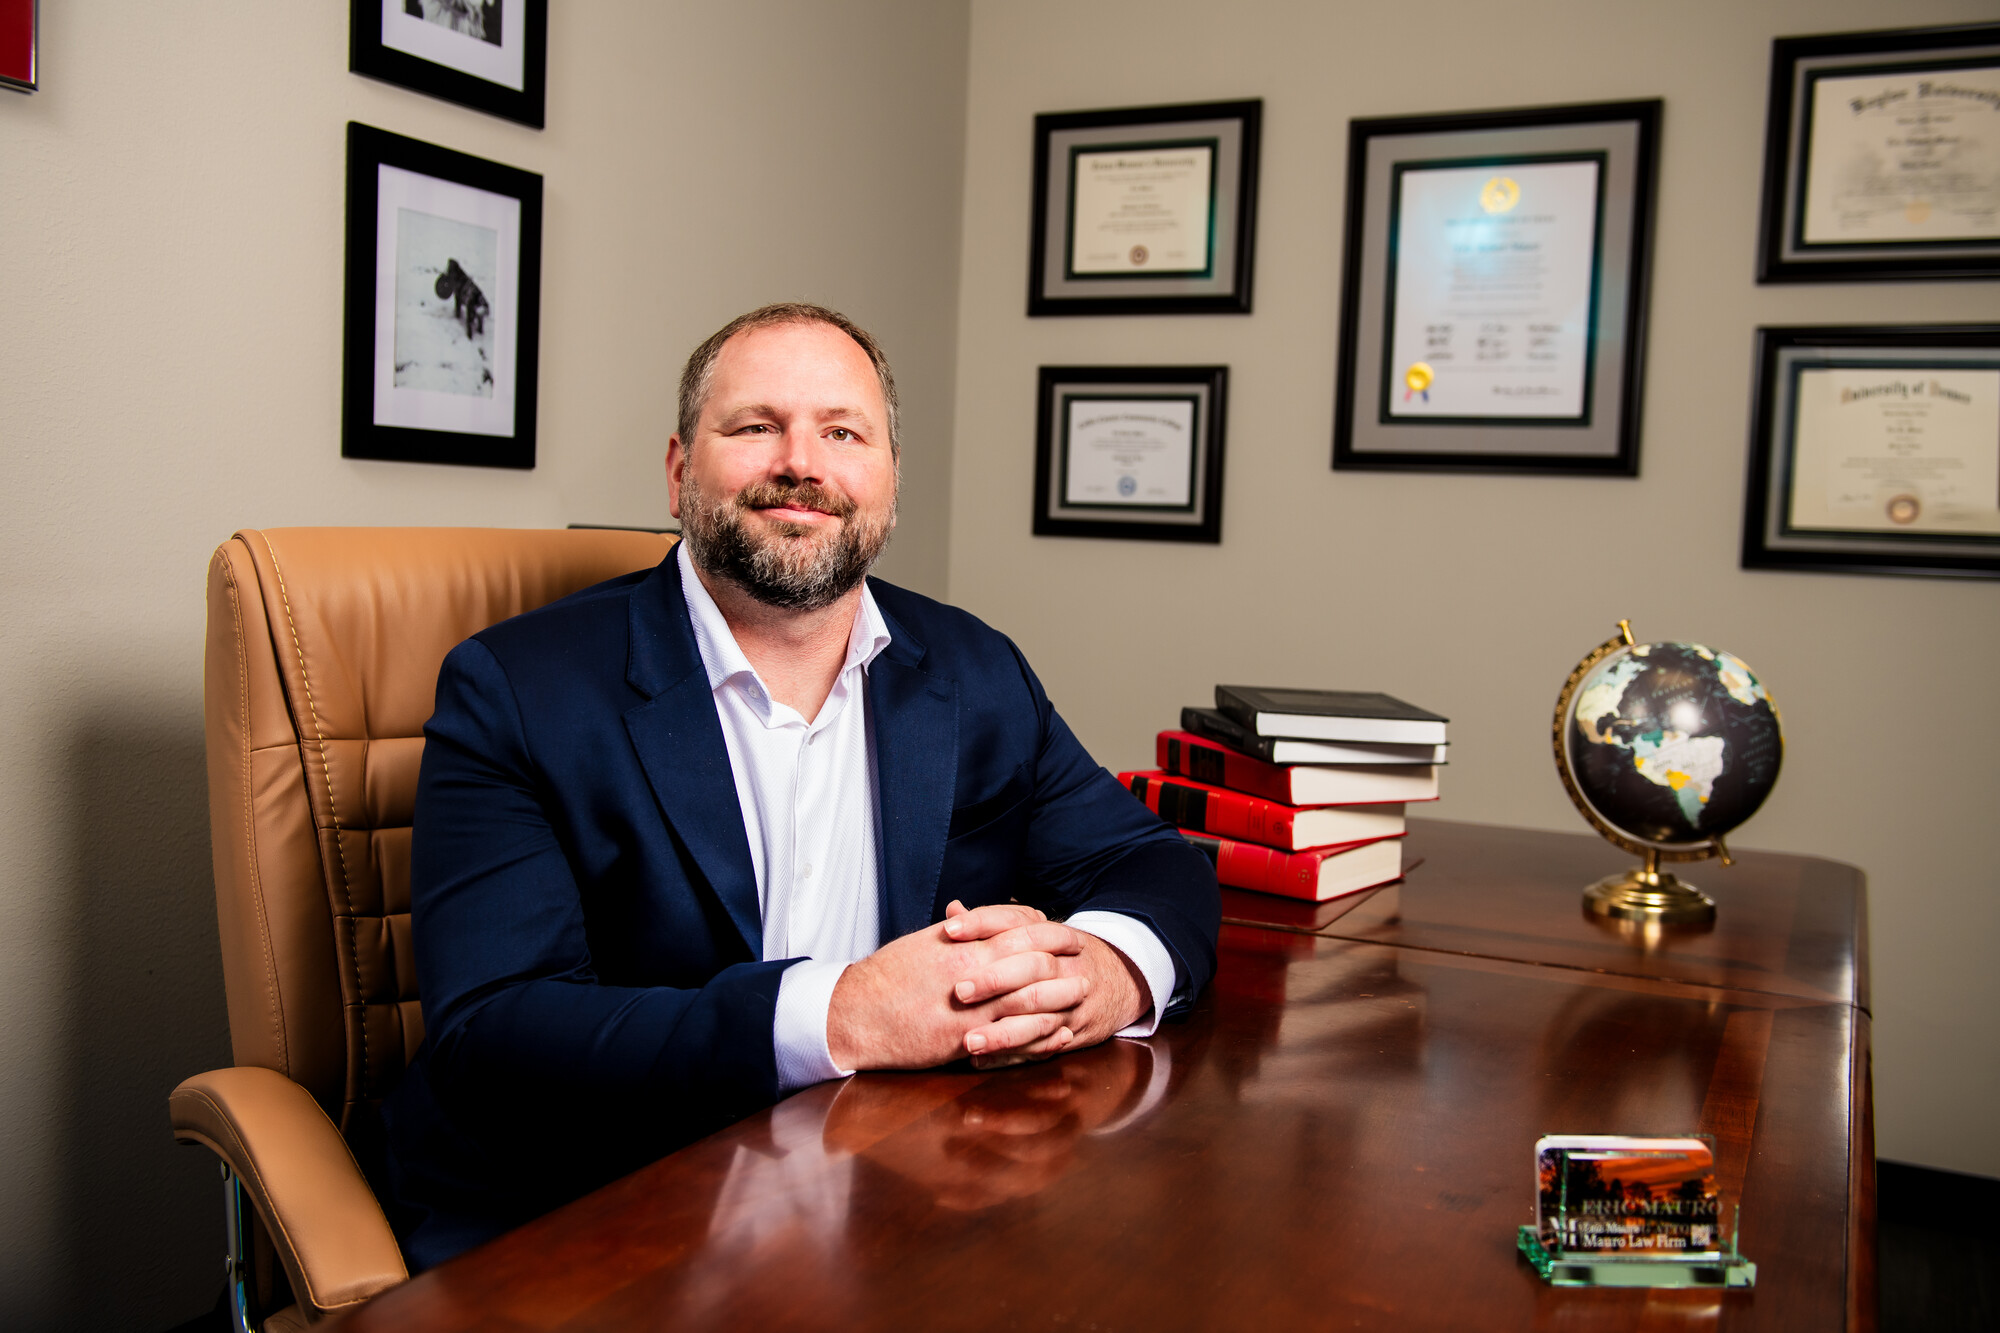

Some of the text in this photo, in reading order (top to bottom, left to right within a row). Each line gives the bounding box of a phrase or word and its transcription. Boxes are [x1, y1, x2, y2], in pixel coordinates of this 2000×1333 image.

[1582, 1199, 1723, 1215] ERIC MAURO
[1583, 1234, 1687, 1248] Mauro Law Firm
